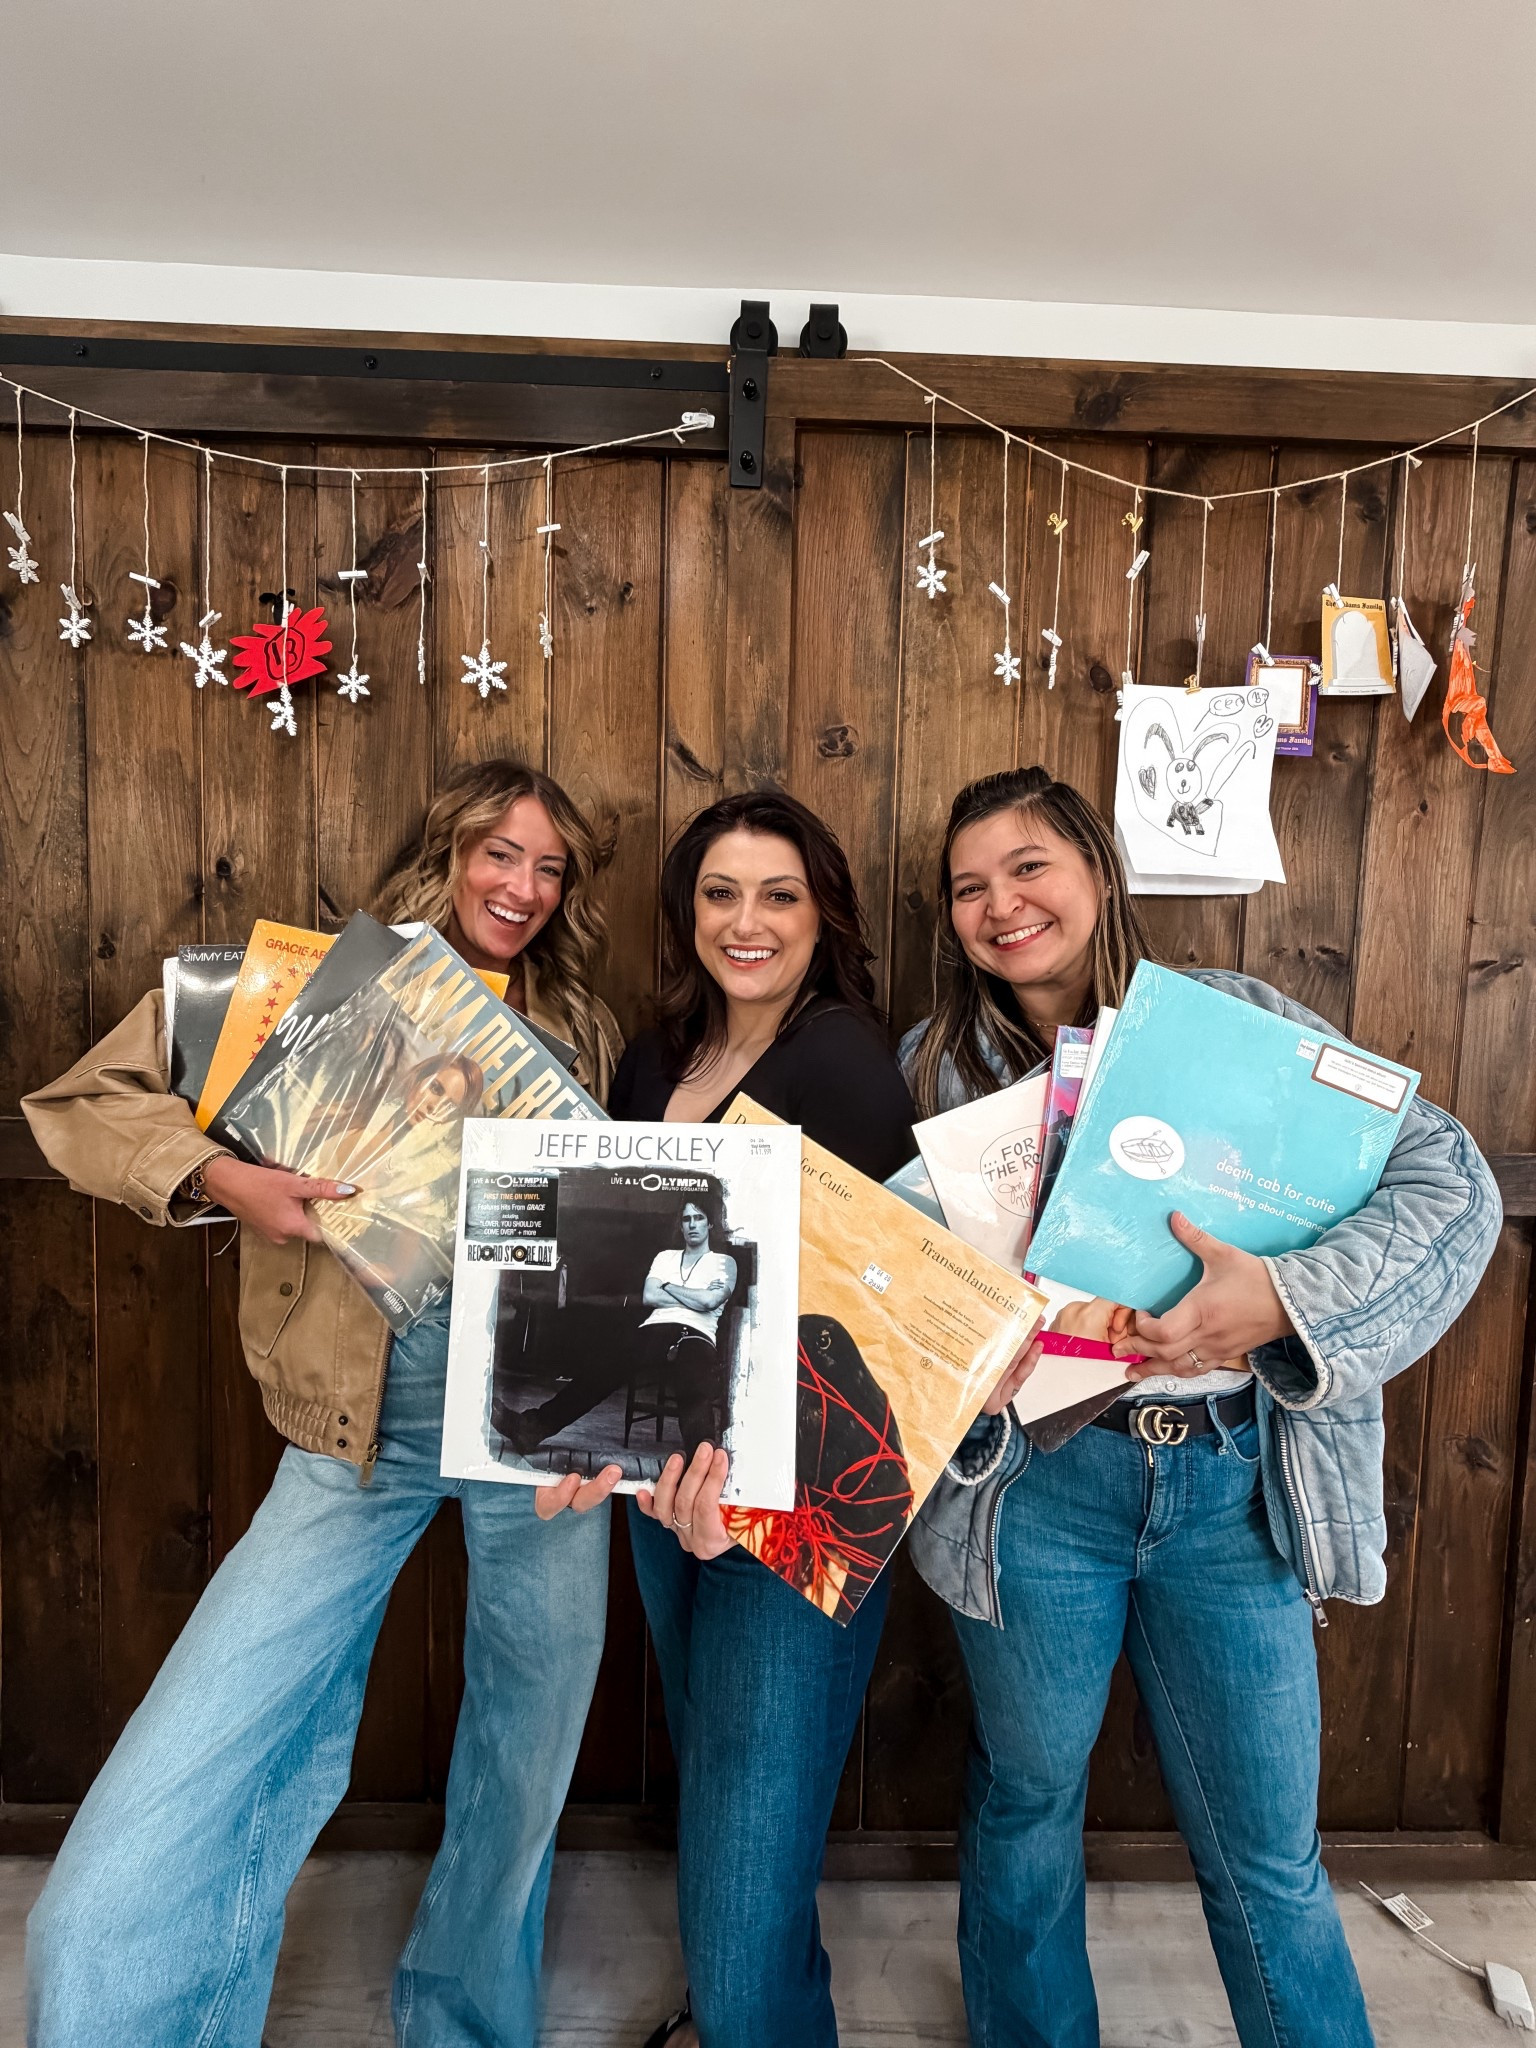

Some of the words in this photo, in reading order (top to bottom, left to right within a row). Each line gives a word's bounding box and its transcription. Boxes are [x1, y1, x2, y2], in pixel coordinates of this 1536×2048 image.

[1362, 603, 1383, 611] Family
[183, 951, 221, 962] JIMMY
[265, 938, 308, 956] GRACIE
[378, 933, 489, 1051] LANA
[534, 1133, 588, 1158] JEFF
[597, 1135, 724, 1163] BUCKLEY
[1001, 1137, 1036, 1161] FOR
[610, 1177, 623, 1185] LIVE
[800, 1157, 817, 1177] for
[819, 1171, 853, 1202] Cutie
[984, 1161, 1018, 1182] THE
[1216, 1159, 1254, 1183] death
[1257, 1176, 1281, 1193] cab
[1283, 1183, 1303, 1201] for
[1305, 1196, 1336, 1214] cutie
[1208, 1183, 1256, 1209] something
[1258, 1202, 1285, 1218] about
[1286, 1213, 1327, 1234] airplanes
[467, 1244, 503, 1262] RECORD
[537, 1245, 553, 1262] DAY
[920, 1237, 1029, 1321] Transatlanticism
